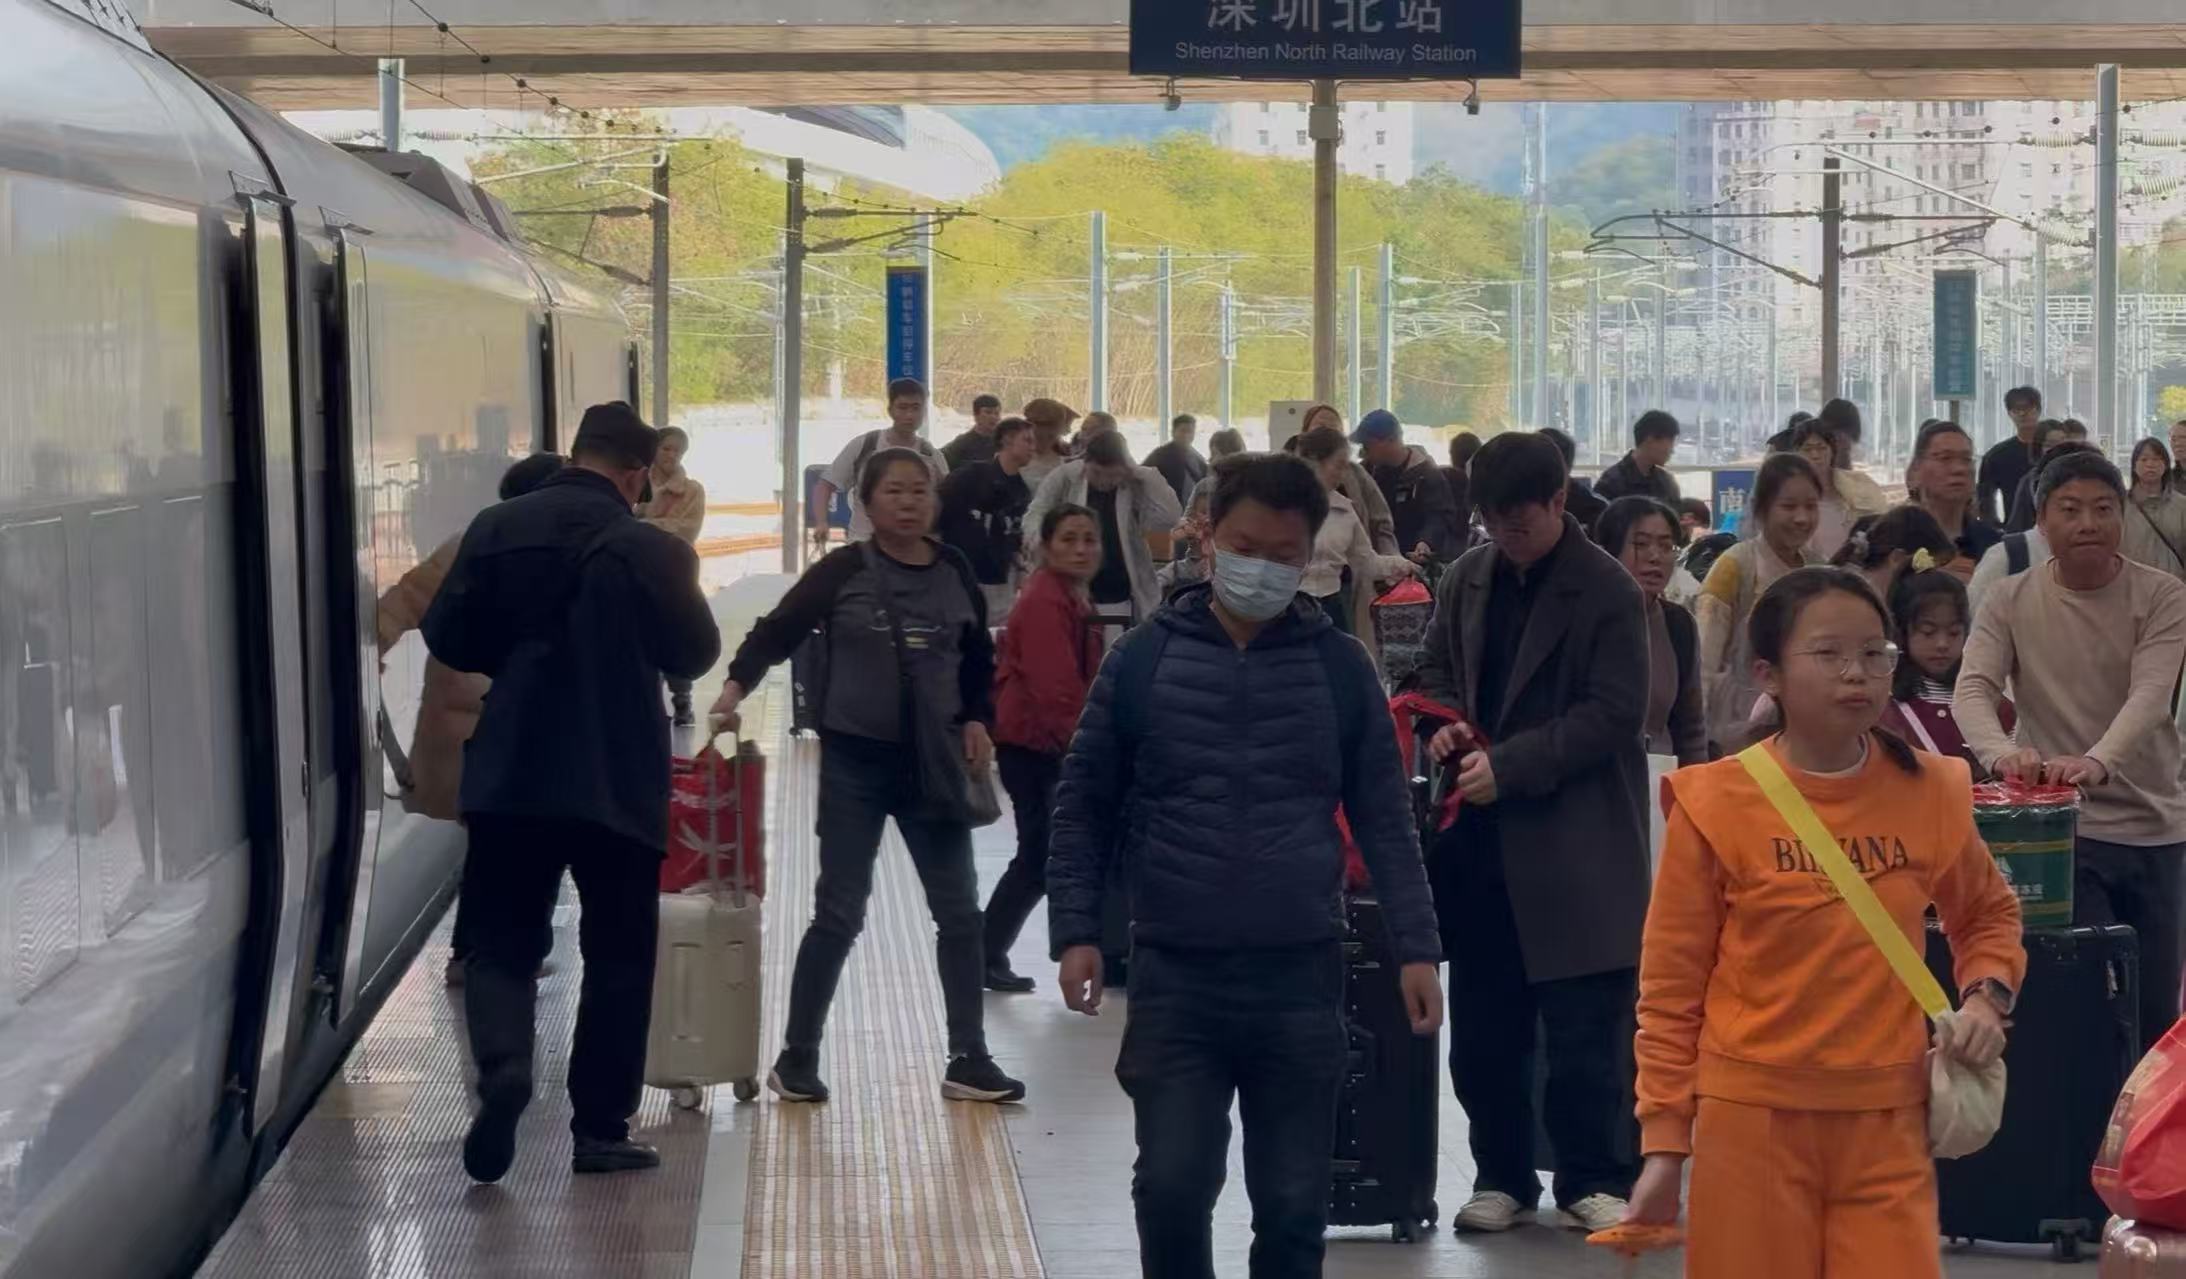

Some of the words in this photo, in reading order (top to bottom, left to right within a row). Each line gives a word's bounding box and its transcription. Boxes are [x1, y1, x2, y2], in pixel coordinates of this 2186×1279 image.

[1207, 0, 1442, 33] 深圳北站
[1175, 42, 1269, 60] Shenzhen
[1275, 43, 1327, 60] North
[1333, 43, 1405, 63] Railway
[1411, 43, 1477, 61] Station
